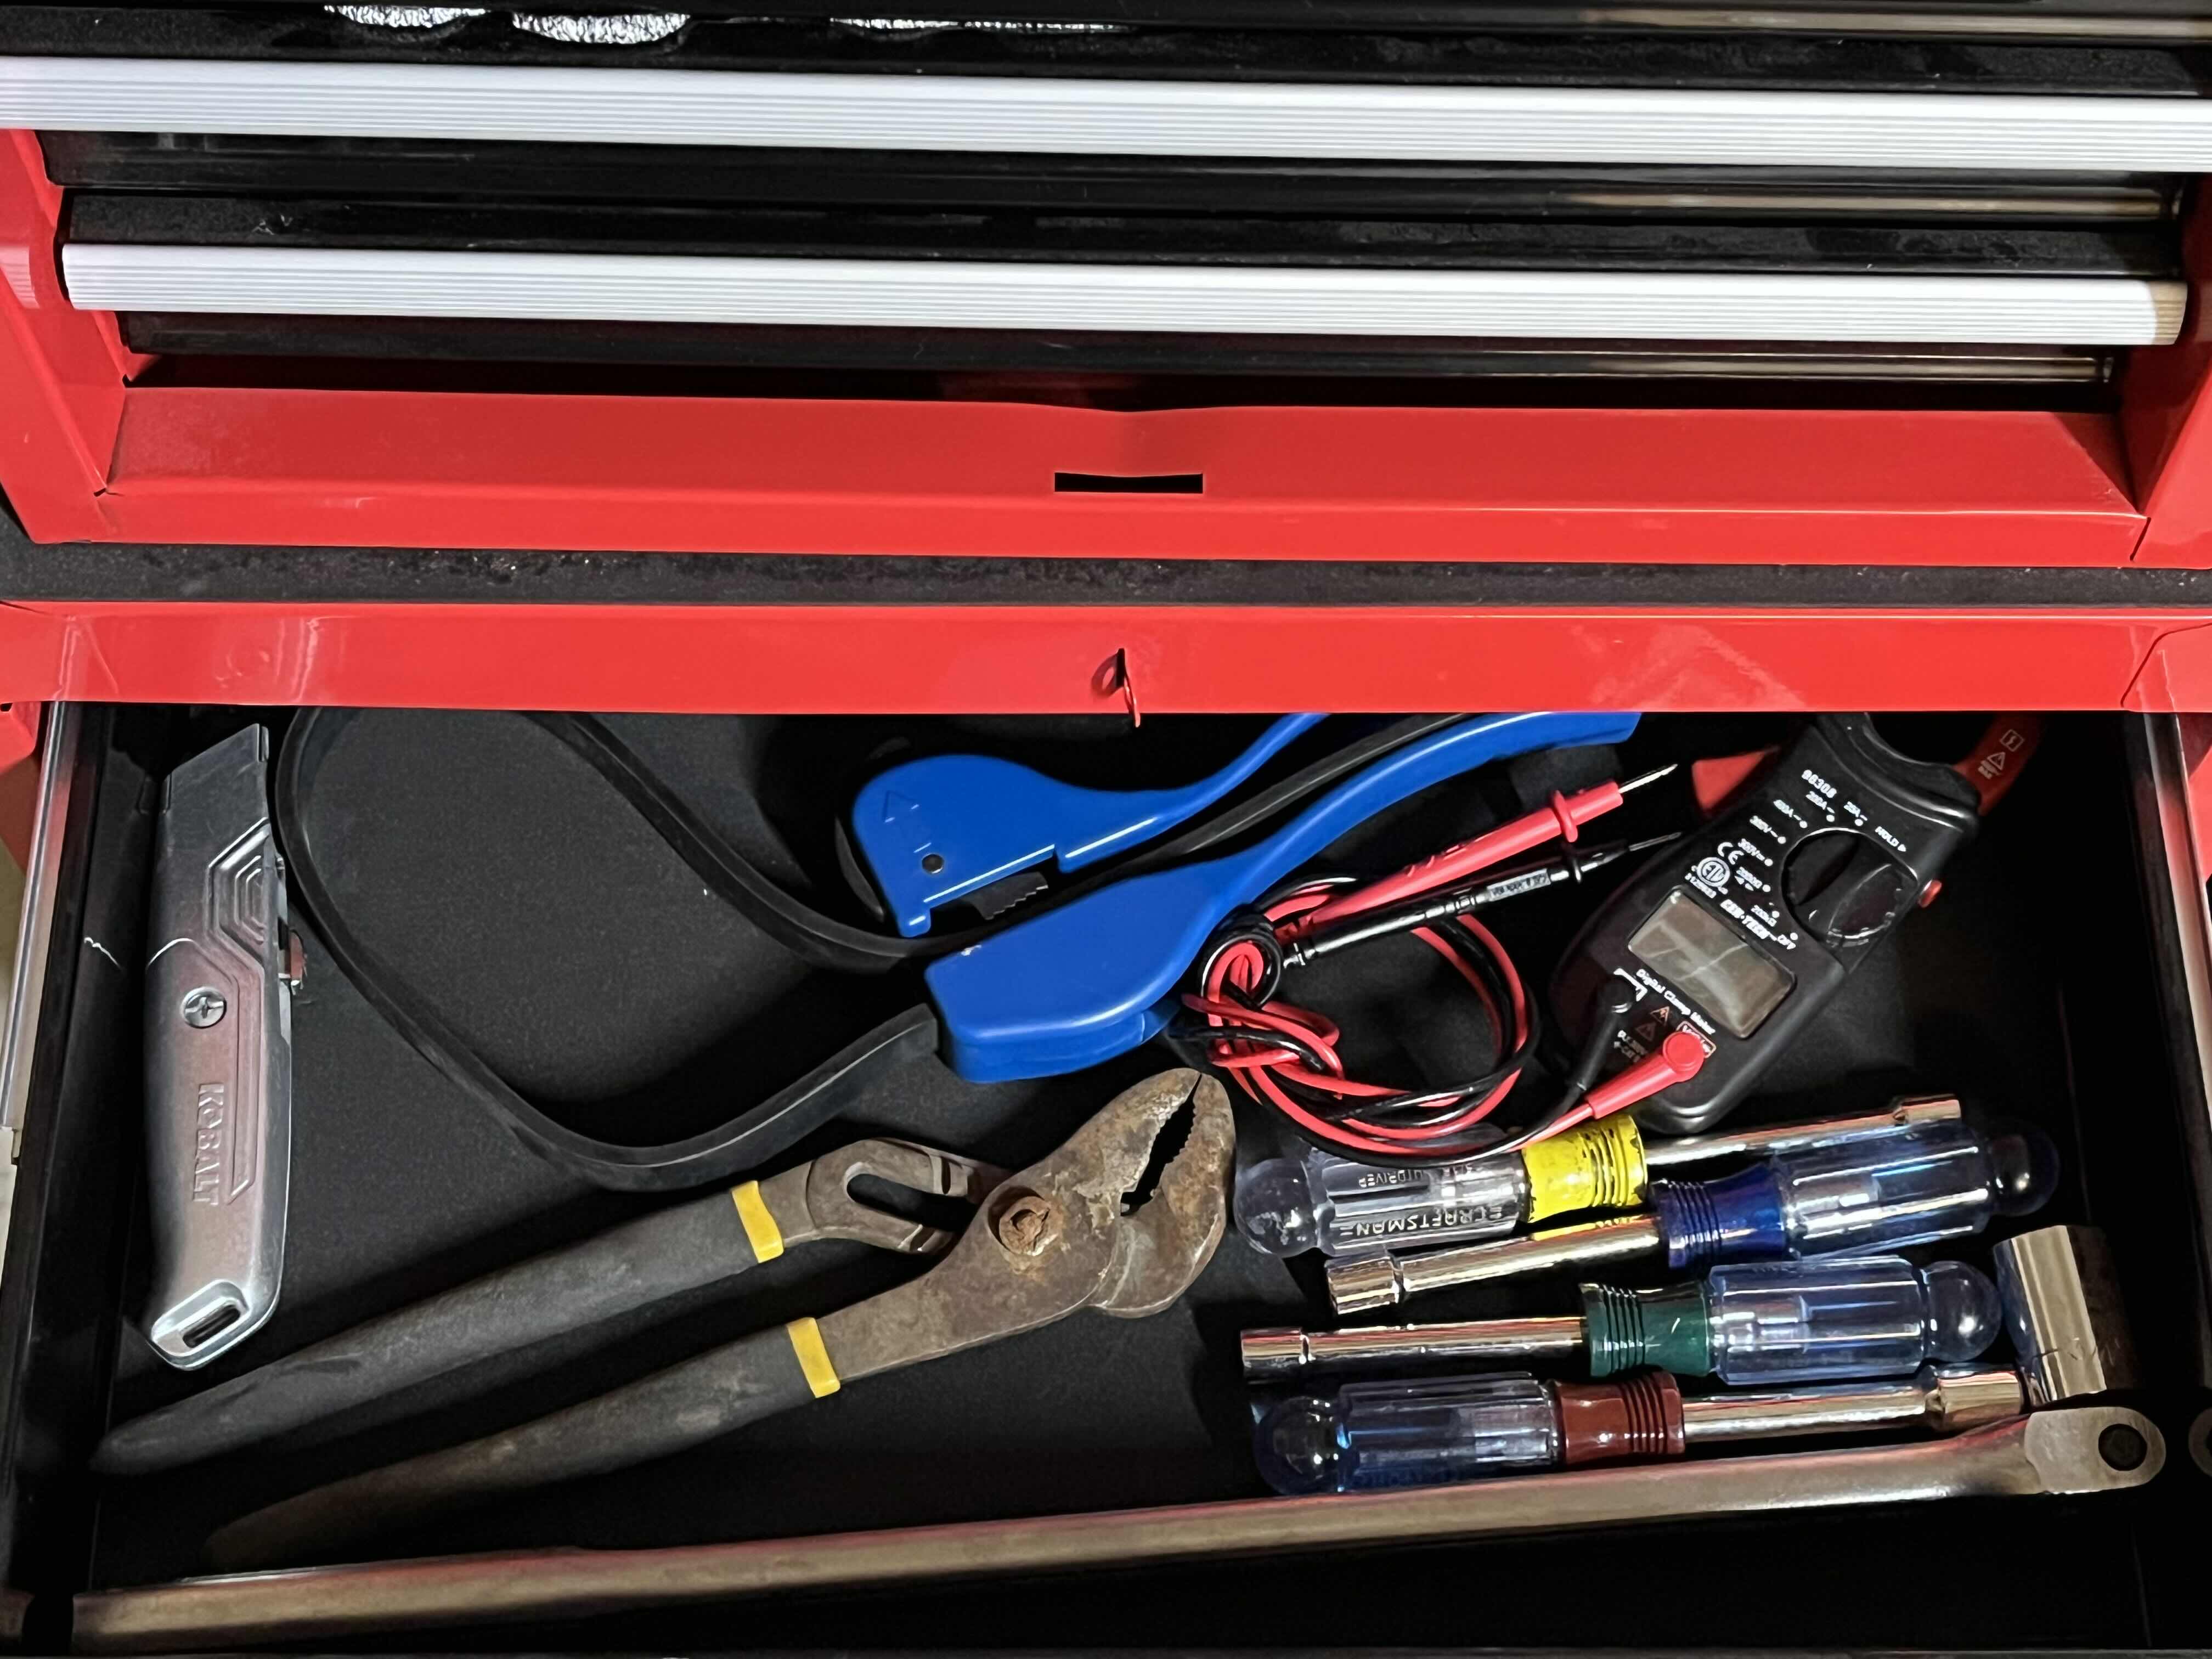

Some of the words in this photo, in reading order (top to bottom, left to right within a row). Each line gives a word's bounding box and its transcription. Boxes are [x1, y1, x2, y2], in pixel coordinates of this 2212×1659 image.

[1636, 968, 1666, 994] Digital
[1663, 990, 1691, 1015] Clamp
[193, 1083, 224, 1206] KOBALT
